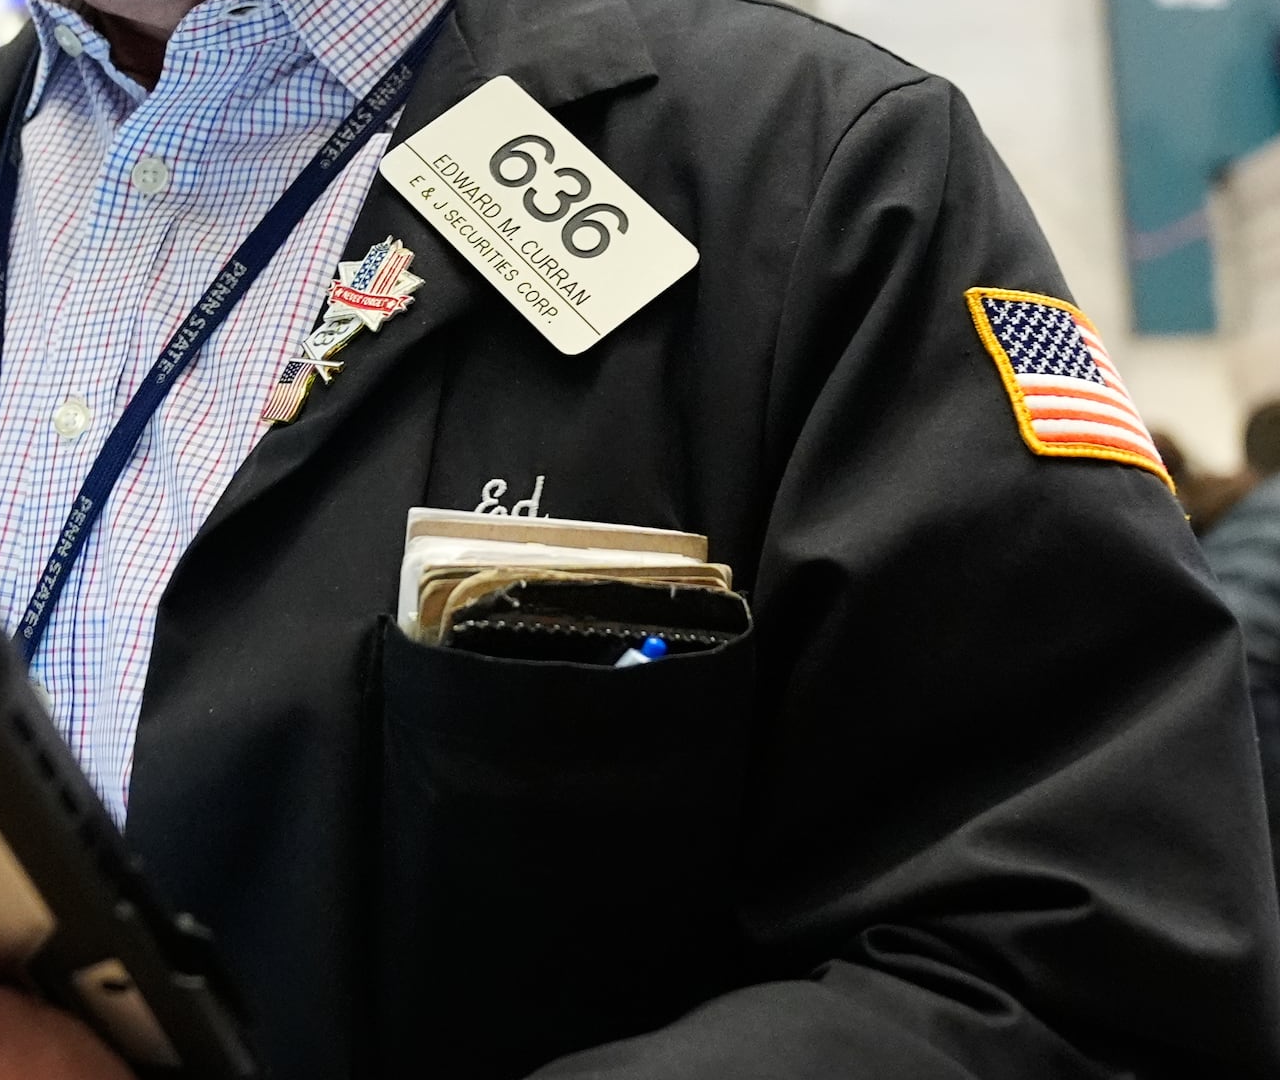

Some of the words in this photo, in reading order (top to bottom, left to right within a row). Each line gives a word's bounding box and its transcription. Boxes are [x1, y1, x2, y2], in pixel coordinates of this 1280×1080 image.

[367, 63, 413, 111] PENN
[488, 134, 630, 259] 636
[408, 174, 426, 188] E
[421, 186, 436, 201] &
[433, 201, 449, 211] J
[444, 209, 519, 282] SECURITIES
[516, 281, 559, 325] CORP.
[432, 154, 503, 219] EDWARD
[497, 217, 522, 241] M.
[520, 240, 592, 306] CURRAN
[200, 260, 248, 315] PENN
[342, 290, 364, 304] NEVER
[361, 296, 390, 308] FORGET
[57, 495, 93, 558] PENN
